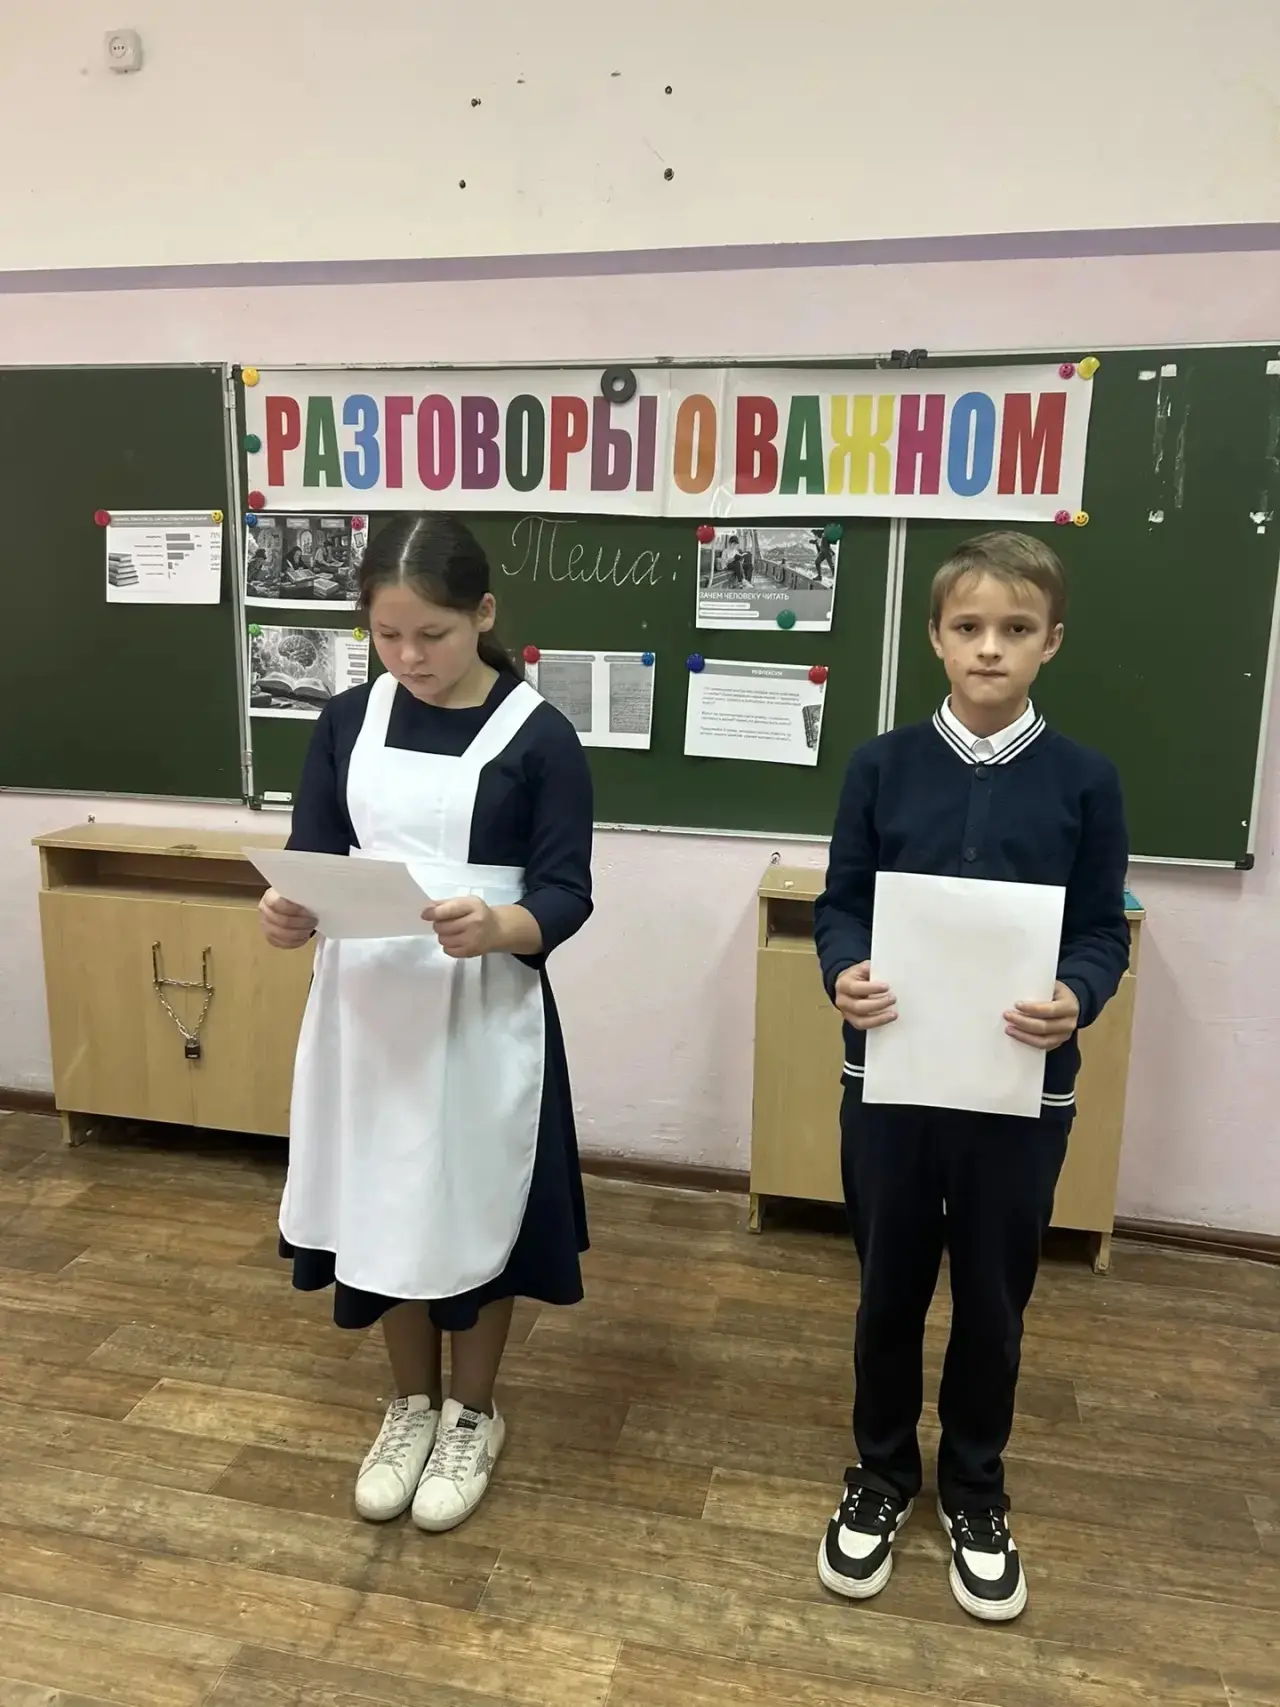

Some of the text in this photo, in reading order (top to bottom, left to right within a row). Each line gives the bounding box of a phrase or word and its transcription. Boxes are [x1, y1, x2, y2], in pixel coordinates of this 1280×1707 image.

[265, 391, 1068, 497] РАЗГОВОРЫ О ВАЖНОМ
[699, 591, 790, 601] ЗАЧЕМ ЧЕЛОВЕКУ ЧИТАТЬ
